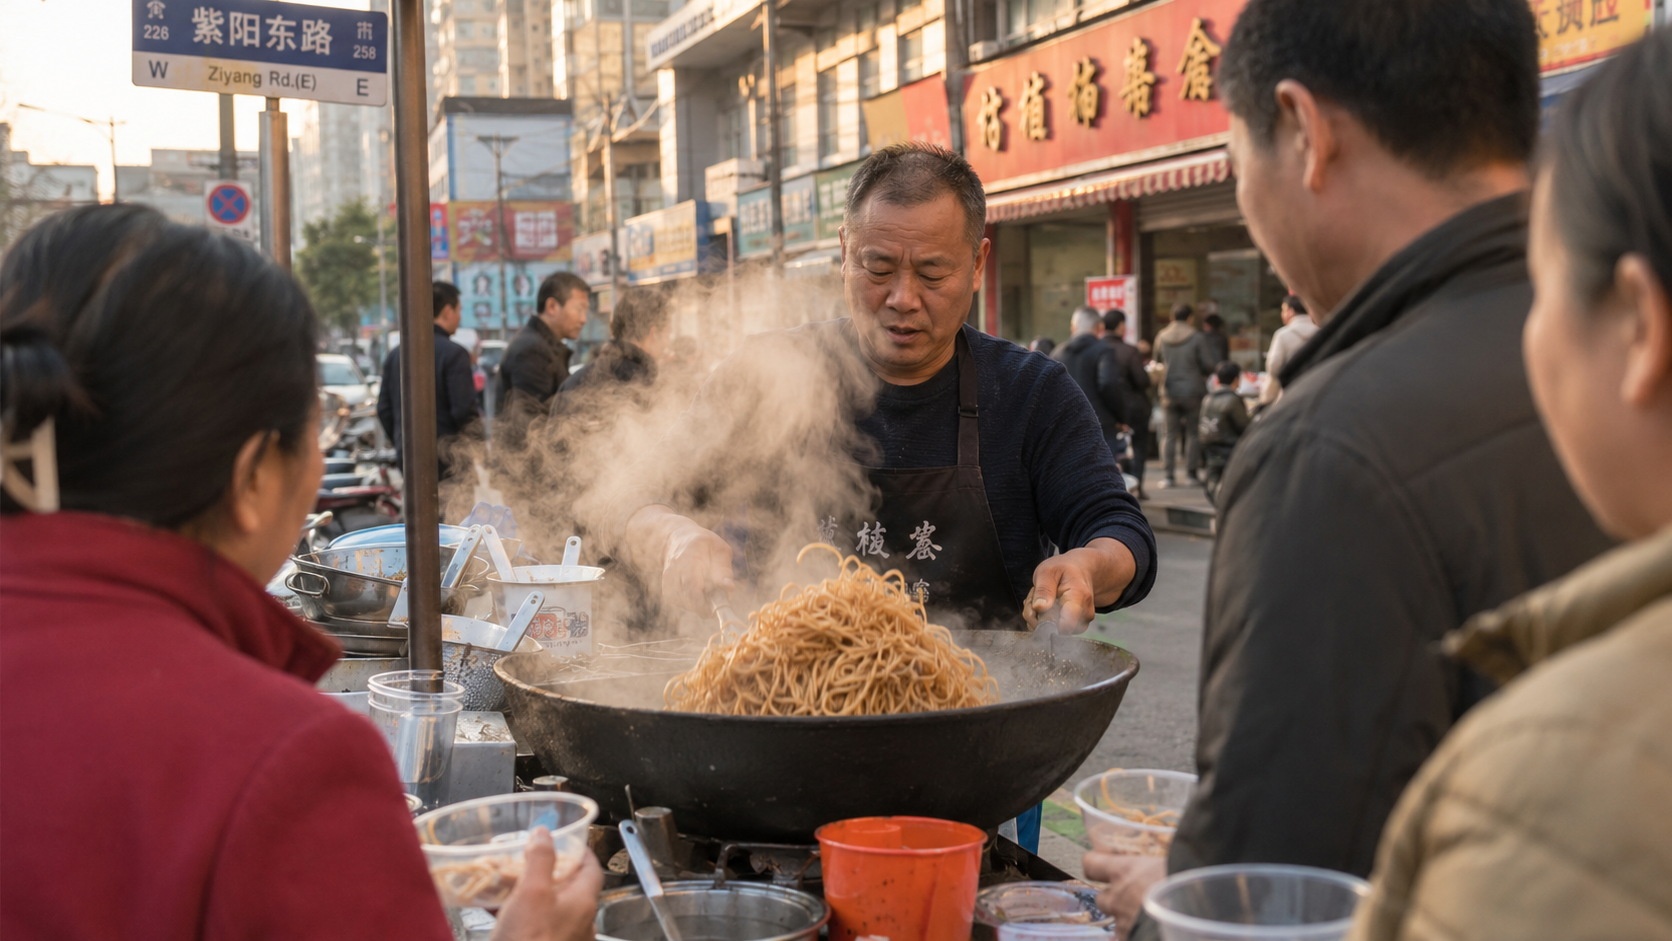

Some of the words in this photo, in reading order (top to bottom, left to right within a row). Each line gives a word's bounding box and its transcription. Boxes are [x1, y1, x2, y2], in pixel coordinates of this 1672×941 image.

[143, 24, 169, 41] 226
[191, 6, 333, 56] 紫阳东路
[353, 44, 376, 60] 258
[148, 60, 168, 79] W
[207, 65, 262, 89] Ziyang
[269, 70, 317, 92] Rd.(E)
[356, 78, 369, 97] E
